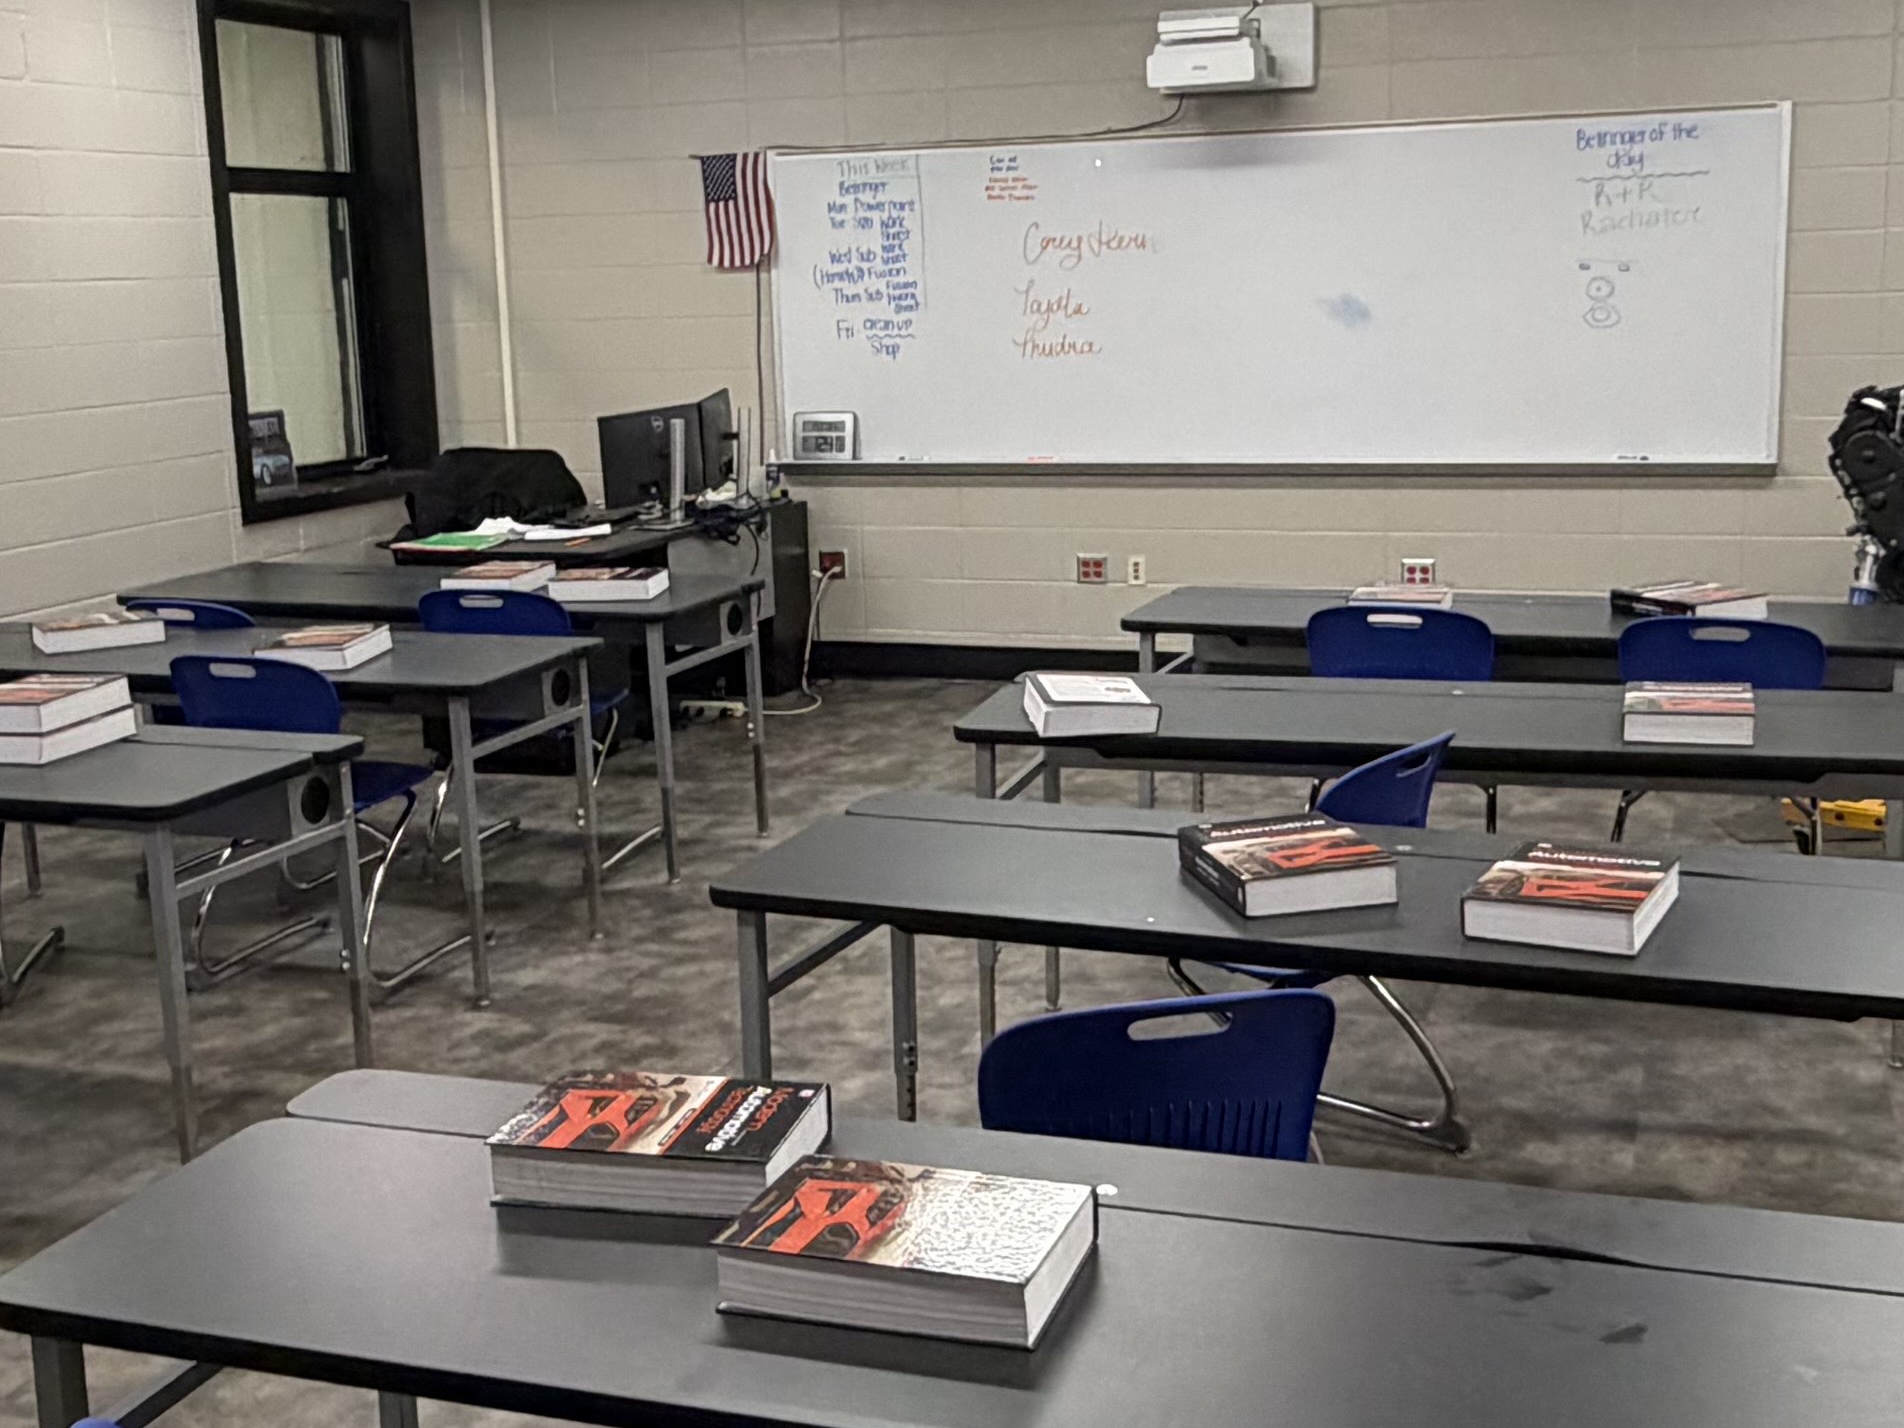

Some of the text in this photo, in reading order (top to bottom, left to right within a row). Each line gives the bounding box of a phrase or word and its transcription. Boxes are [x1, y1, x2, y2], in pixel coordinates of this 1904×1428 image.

[1649, 122, 1668, 142] of
[1672, 123, 1699, 141] the
[1527, 850, 1662, 867] Automotive
[705, 1085, 773, 1152] Automotive
